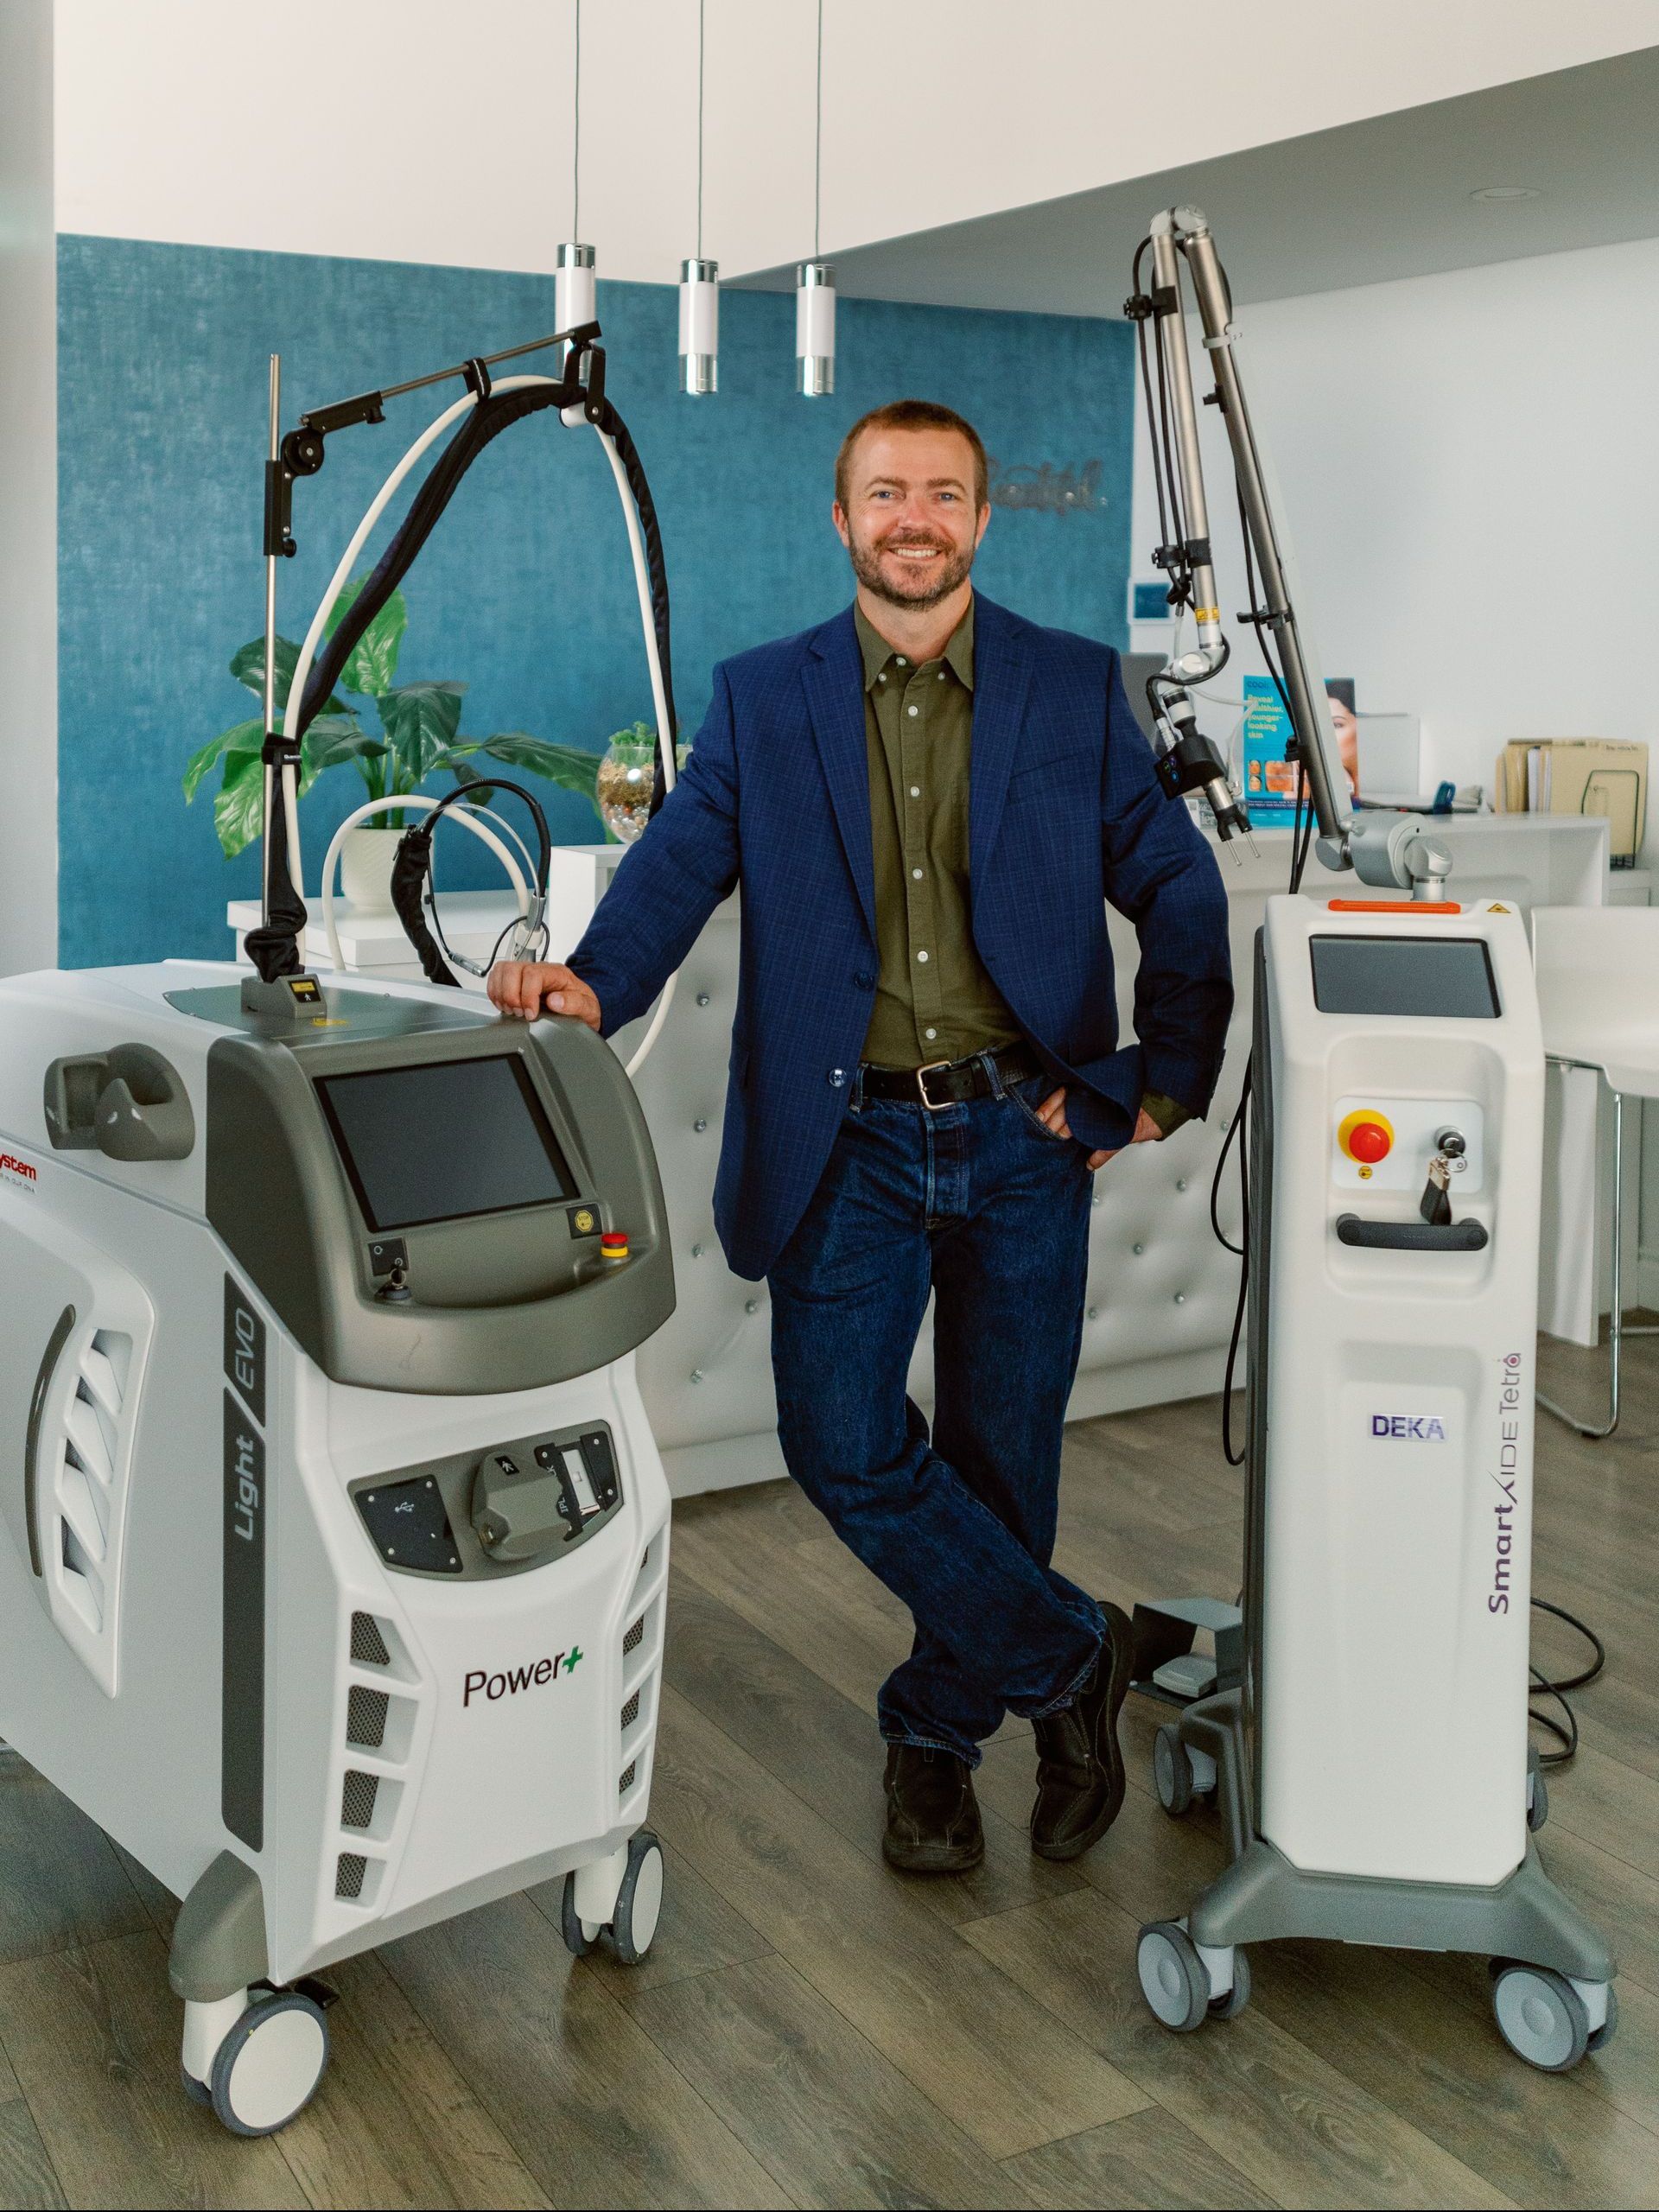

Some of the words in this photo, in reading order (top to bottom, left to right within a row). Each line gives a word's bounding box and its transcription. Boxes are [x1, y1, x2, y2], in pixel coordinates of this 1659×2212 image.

[235, 1307, 255, 1390] EVO
[1372, 1415, 1445, 1440] DEKA
[234, 1434, 258, 1541] Light
[558, 1497, 569, 1514] IPL
